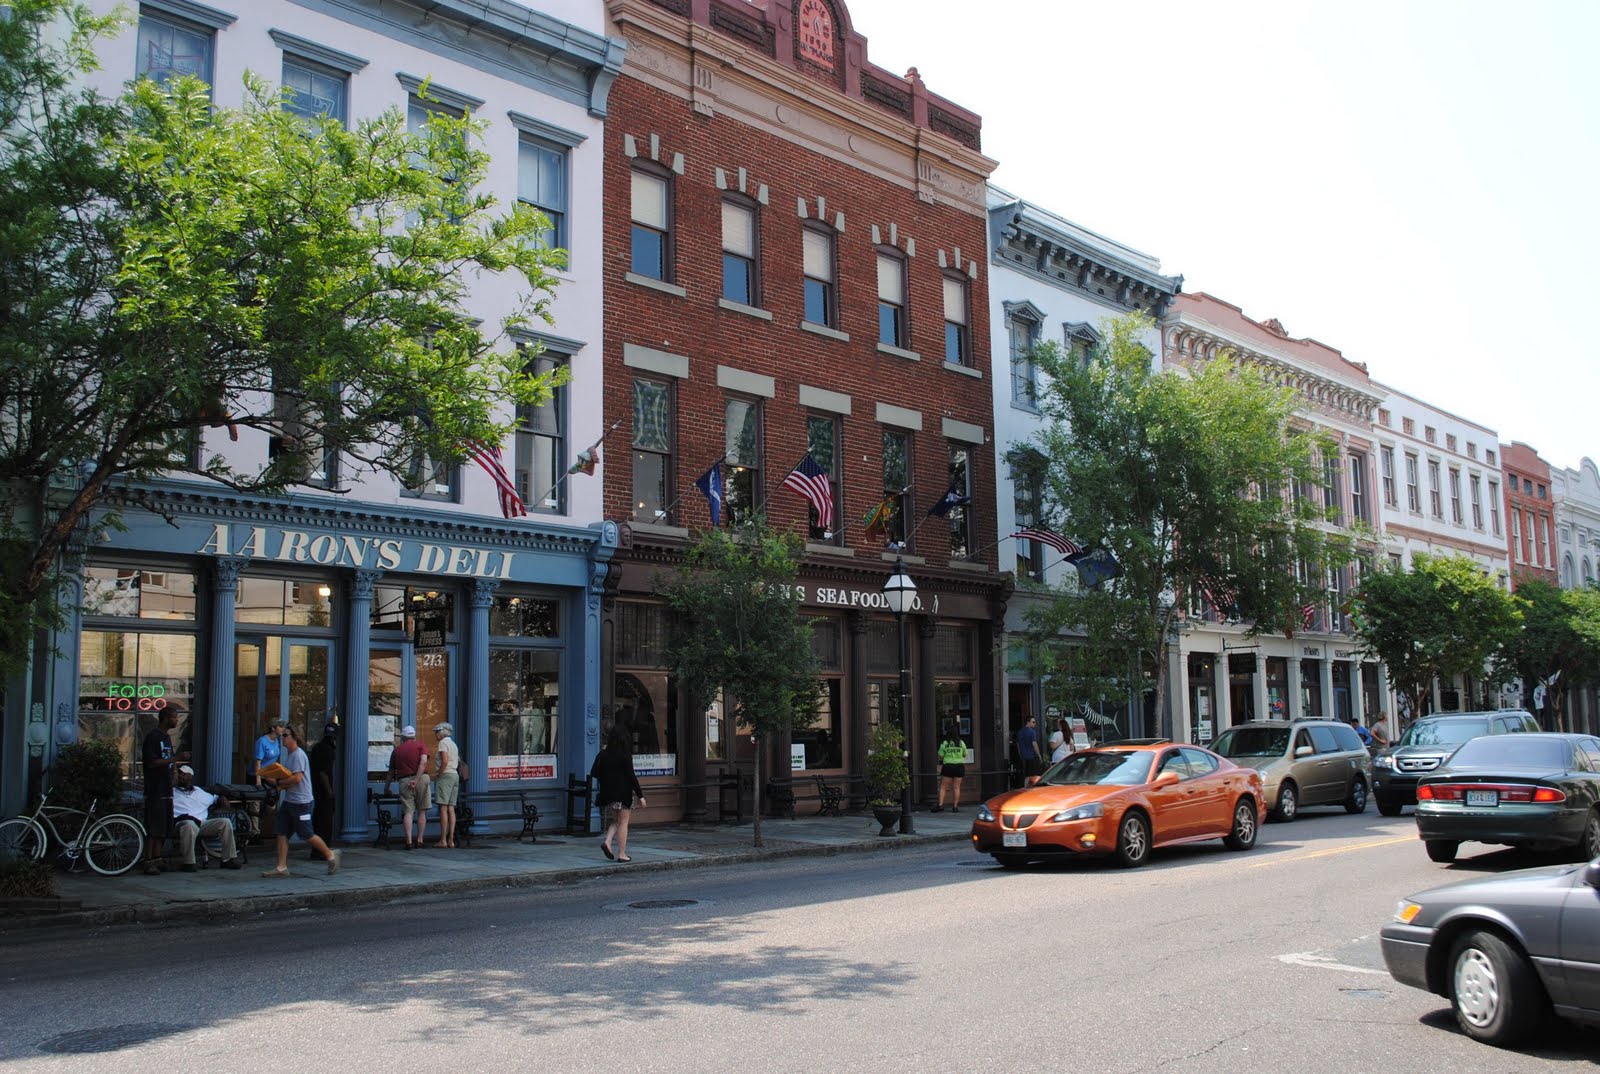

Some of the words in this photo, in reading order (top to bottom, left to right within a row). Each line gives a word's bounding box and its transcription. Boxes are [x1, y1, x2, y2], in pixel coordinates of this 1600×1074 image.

[196, 523, 403, 570] AARON'S
[414, 543, 516, 579] DELI
[423, 654, 442, 666] 213
[109, 685, 165, 698] FOOD
[105, 697, 131, 711] TO
[138, 697, 167, 711] GO
